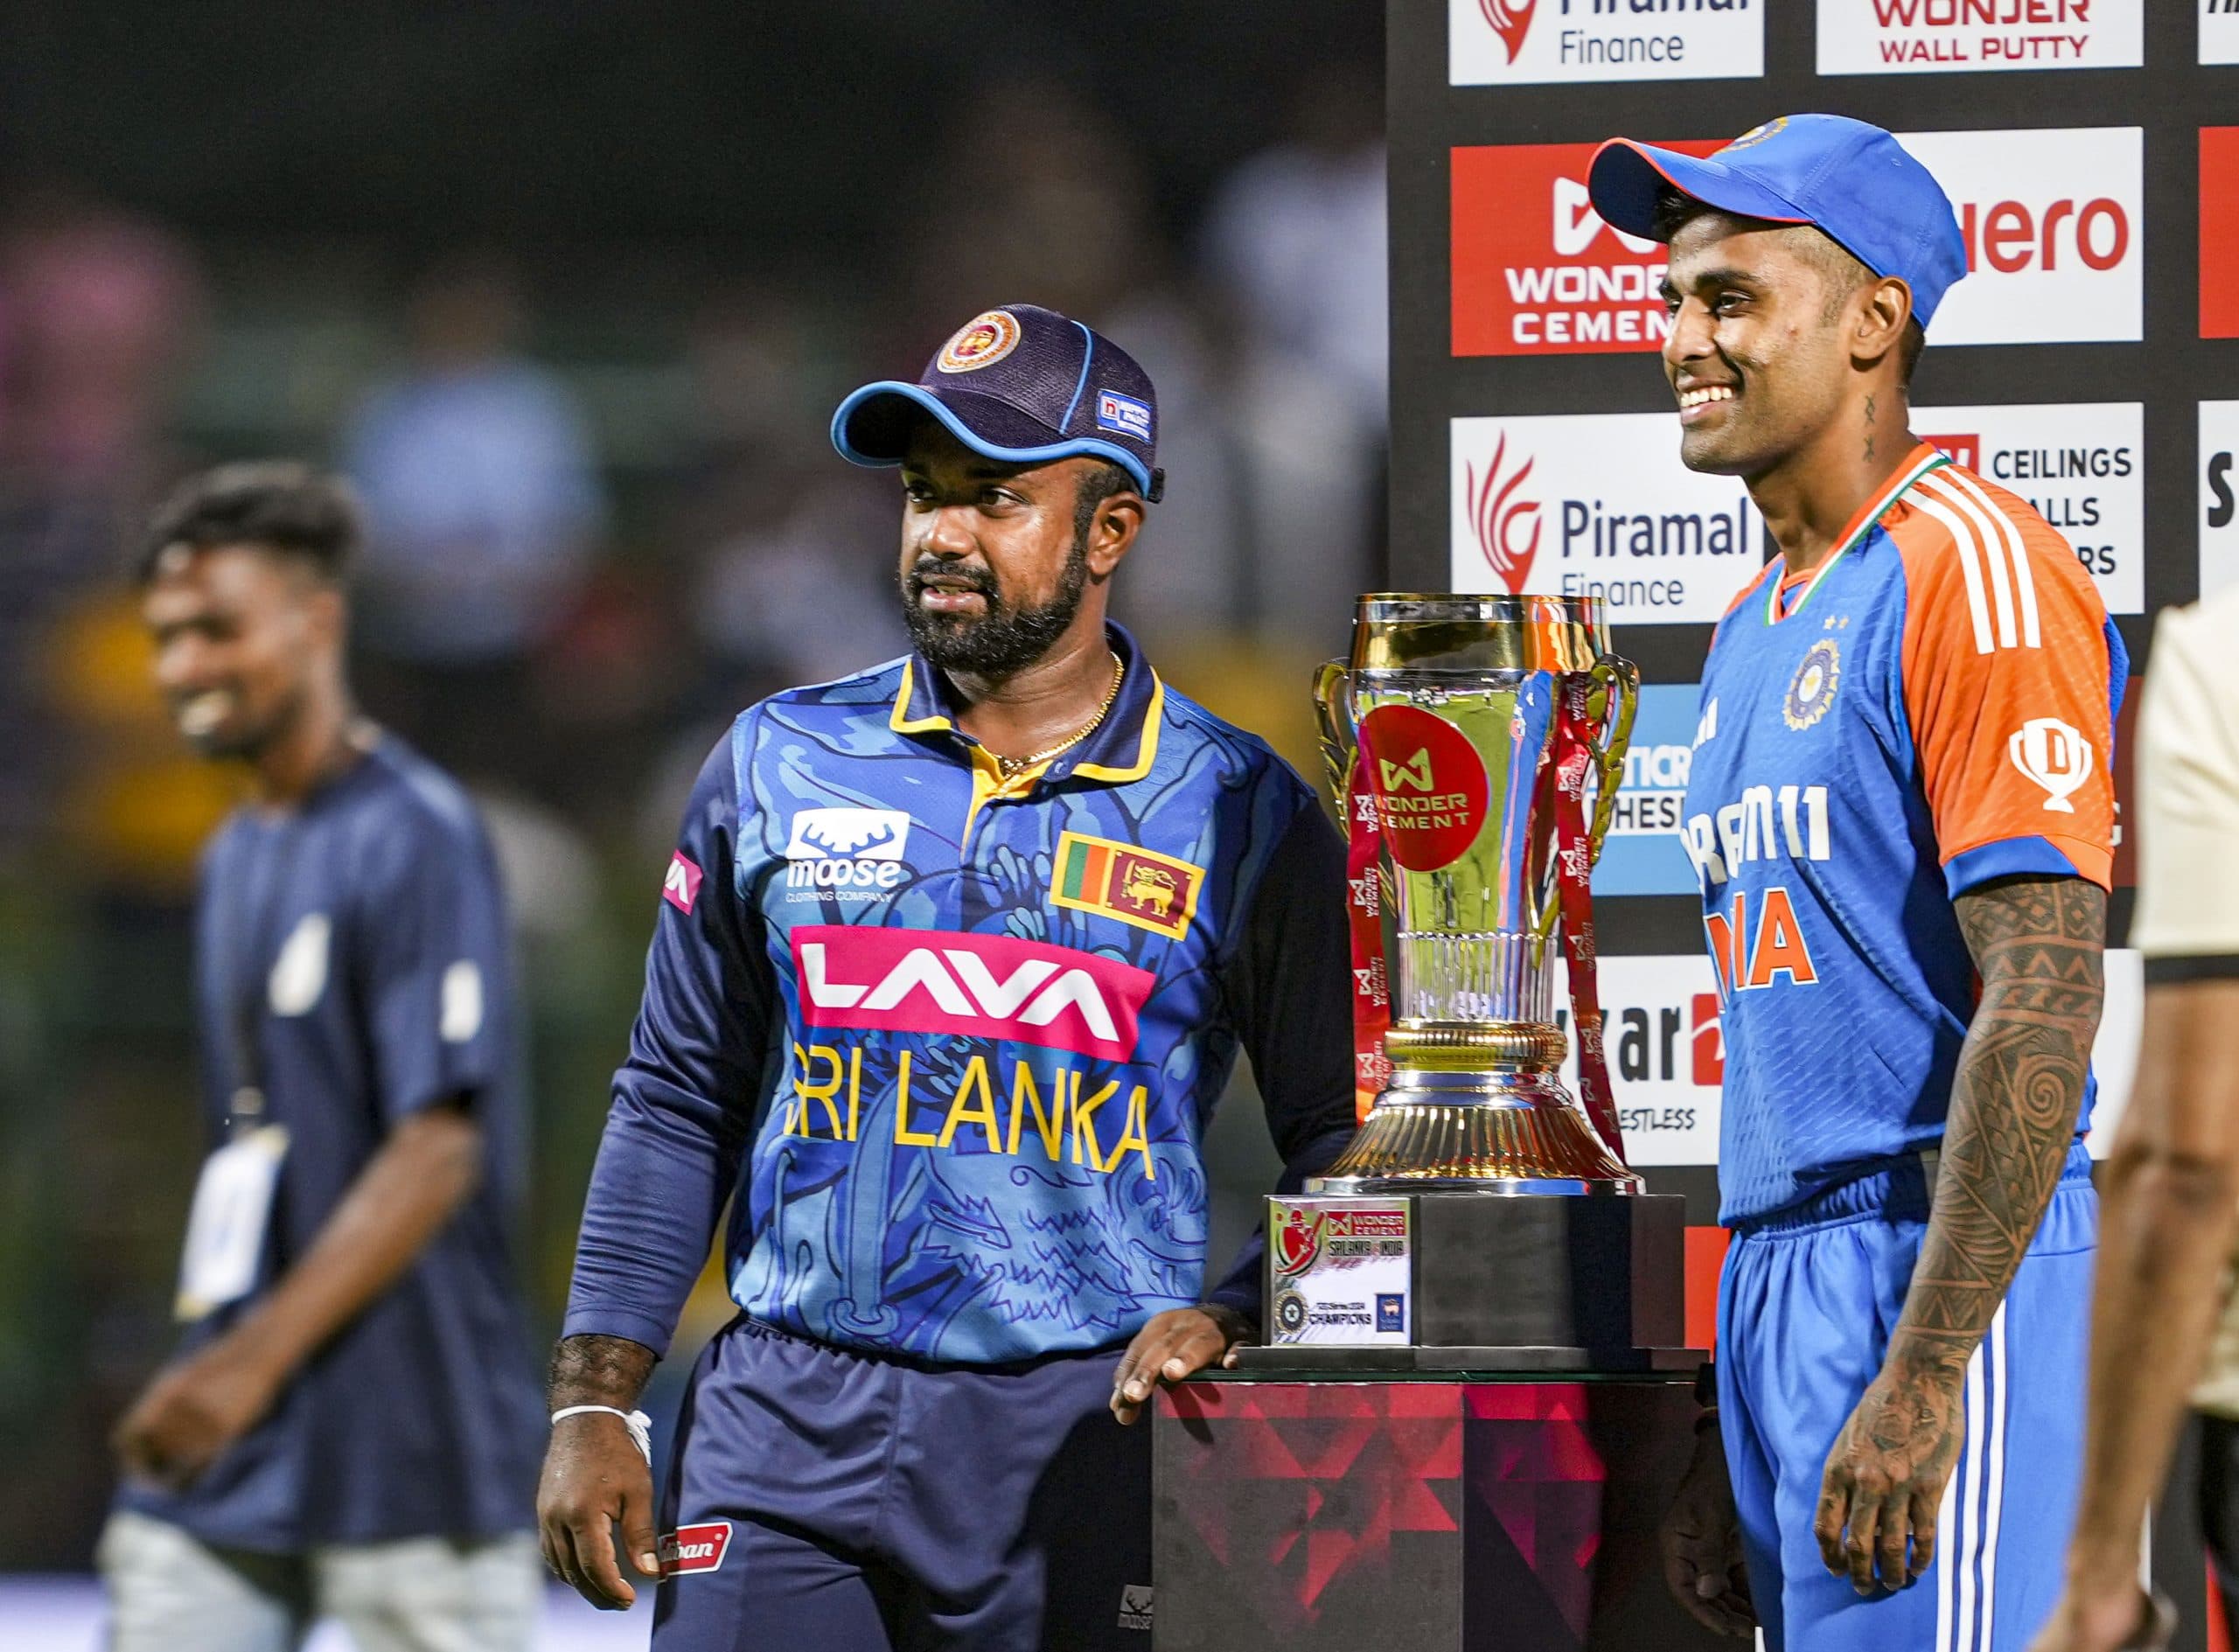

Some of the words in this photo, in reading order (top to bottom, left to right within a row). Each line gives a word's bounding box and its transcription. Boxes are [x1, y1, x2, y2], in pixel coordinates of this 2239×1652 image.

[1560, 31, 1684, 65] Finance
[1880, 39, 1968, 63] WALL
[1981, 34, 2089, 59] PUTTY
[1504, 264, 1669, 303] WONDE
[1512, 310, 1673, 345] CEMEN
[1993, 448, 2131, 479] CEILINGS
[1561, 497, 1747, 558] Piramal
[1592, 797, 1685, 829] HES
[787, 858, 902, 889] moose
[785, 891, 834, 903] CLOTHING
[835, 891, 896, 903] COMPANY
[800, 943, 1120, 1042] LAVA
[894, 1049, 1155, 1181] LANKA
[1619, 1107, 1696, 1132] ESTLESS
[1309, 1313, 1371, 1326] CHAMPIONS
